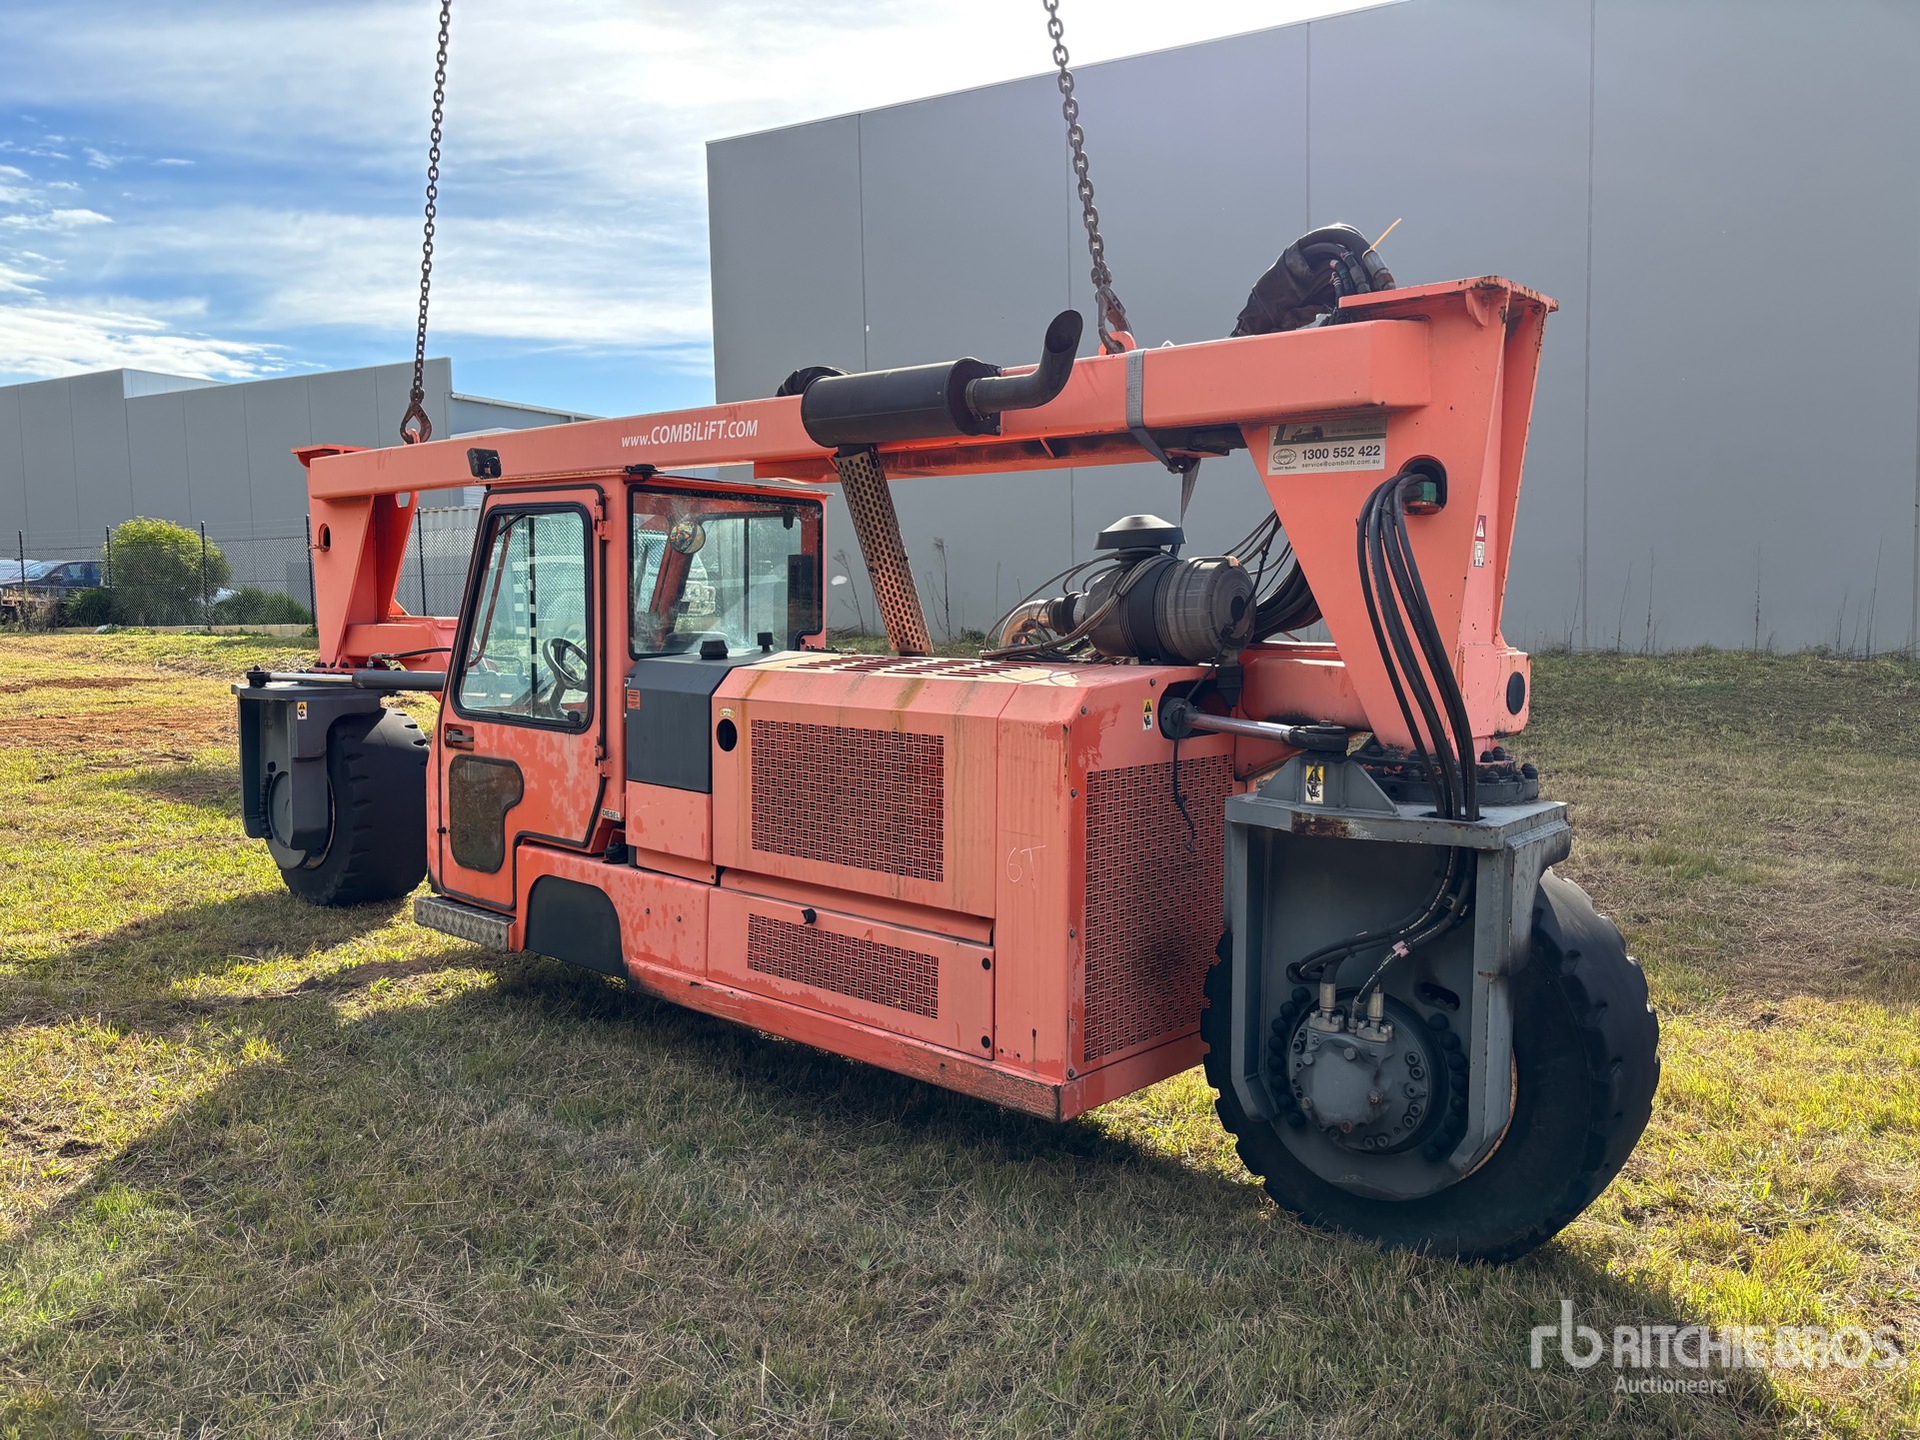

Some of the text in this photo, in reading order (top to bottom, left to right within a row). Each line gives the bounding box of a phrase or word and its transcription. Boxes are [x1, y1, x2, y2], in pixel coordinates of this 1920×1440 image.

[621, 419, 758, 448] www.COMBiLiFT.COM
[1302, 444, 1381, 460] 1300 552 422
[602, 809, 620, 820] DIESEL
[1006, 844, 1047, 889] 6T
